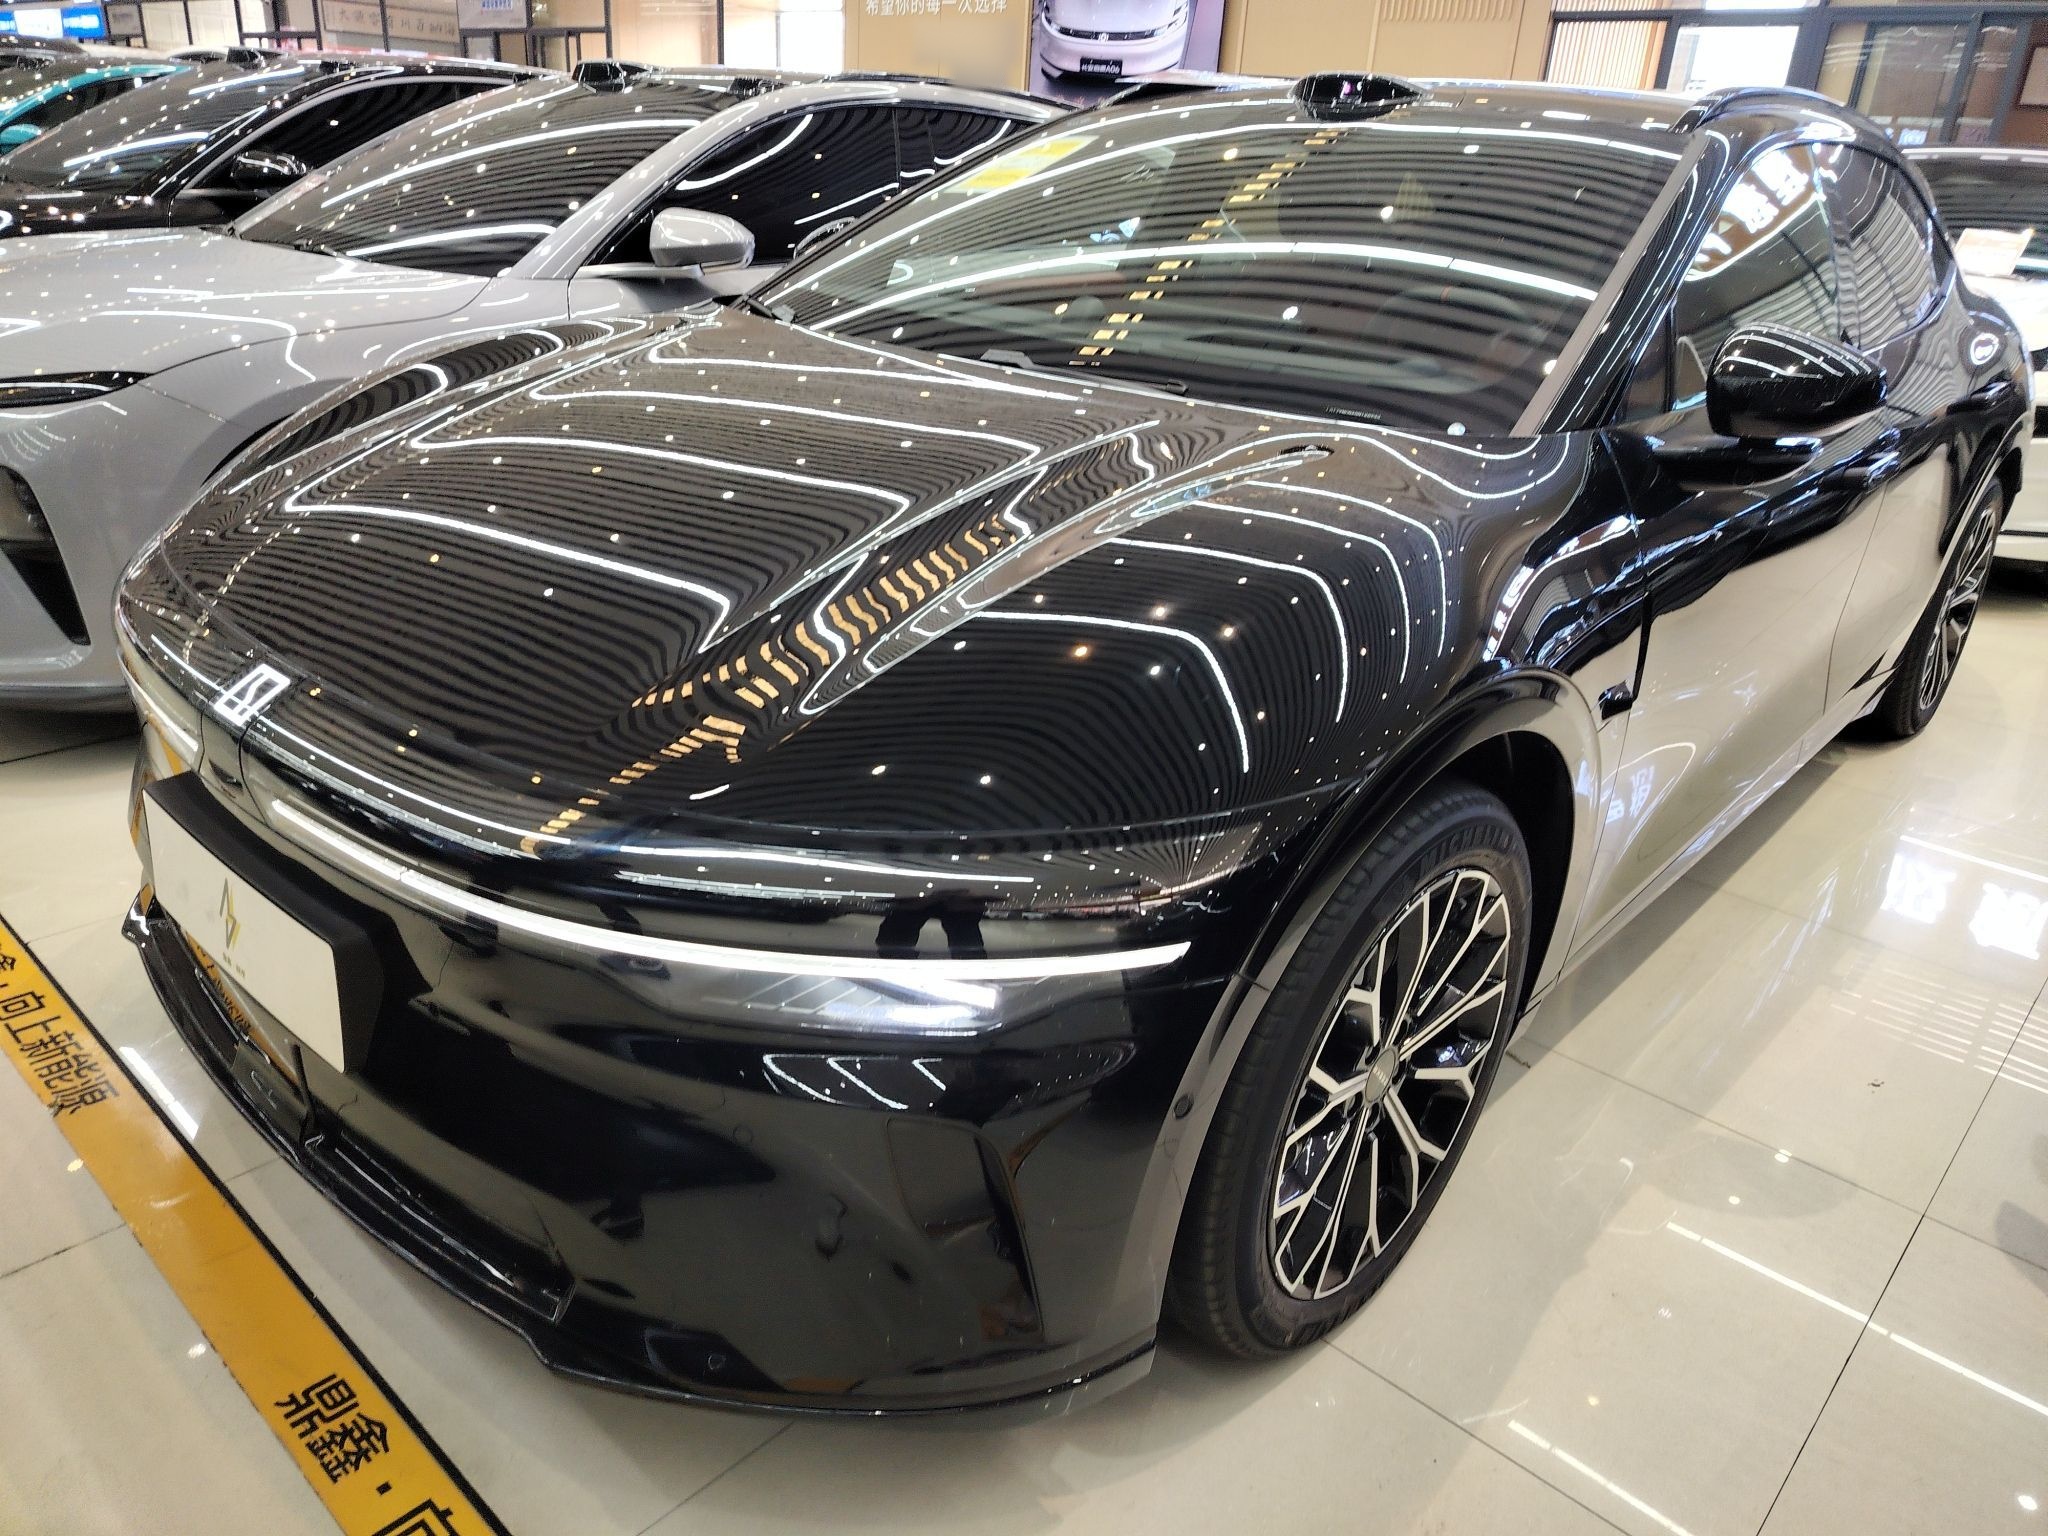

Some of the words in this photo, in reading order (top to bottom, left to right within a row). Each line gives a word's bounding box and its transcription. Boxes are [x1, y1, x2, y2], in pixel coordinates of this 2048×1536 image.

[865, 0, 1008, 16] 希望你的每一次选择
